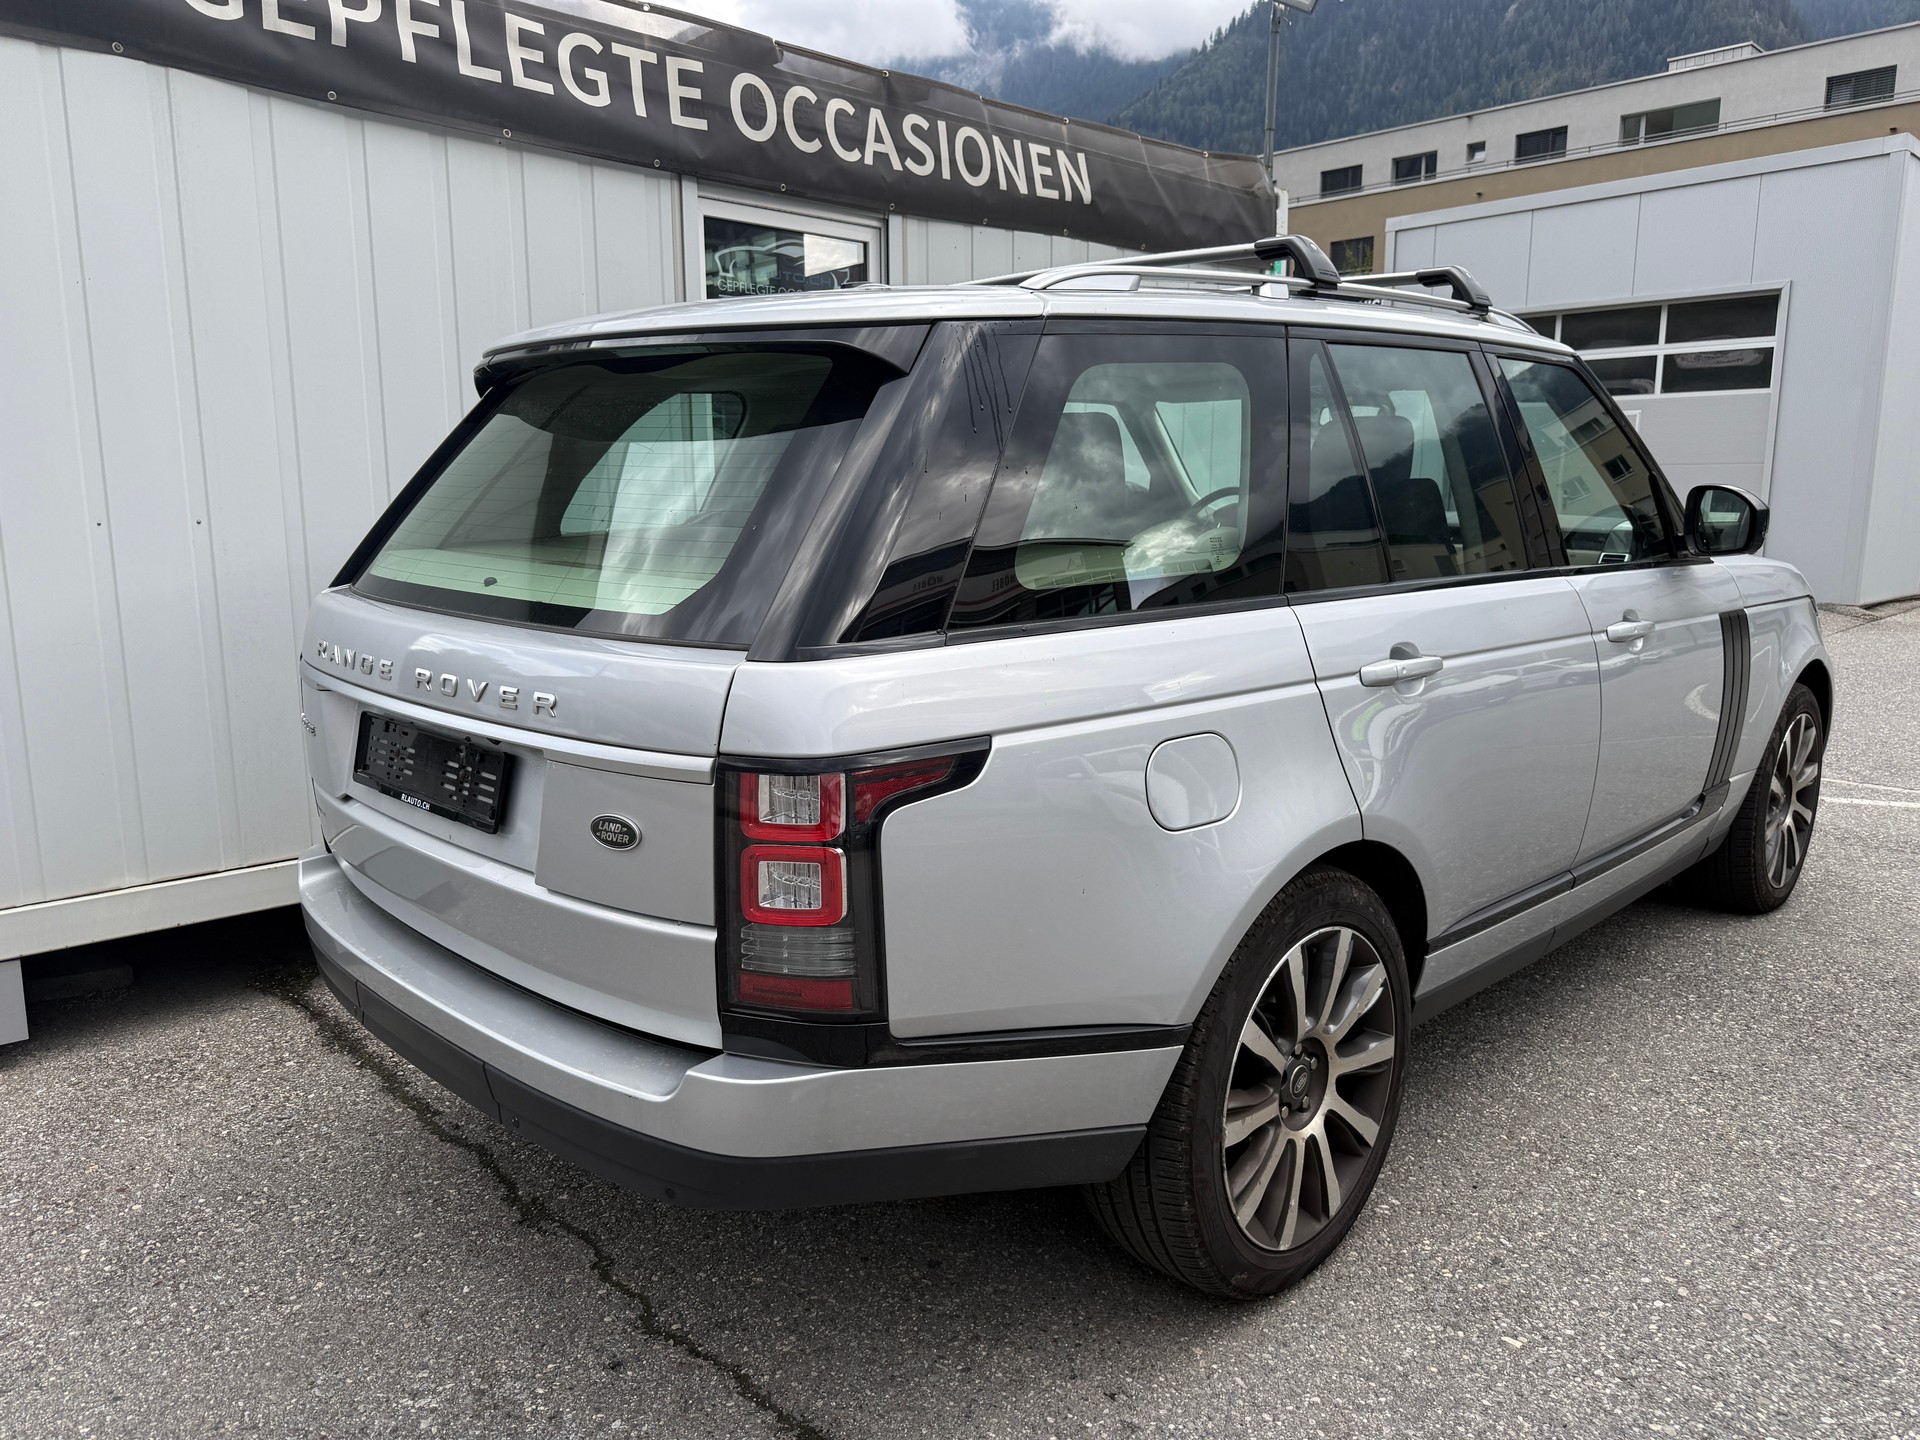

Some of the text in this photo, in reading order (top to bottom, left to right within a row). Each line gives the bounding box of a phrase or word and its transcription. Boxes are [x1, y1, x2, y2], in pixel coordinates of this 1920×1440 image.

[184, 0, 1092, 205] PFLEGTE OCCASIONEN
[317, 638, 559, 718] RANGE ROVER
[401, 793, 430, 811] RLAUTO.CH
[598, 820, 622, 833] LAND
[600, 831, 630, 844] ROVER
